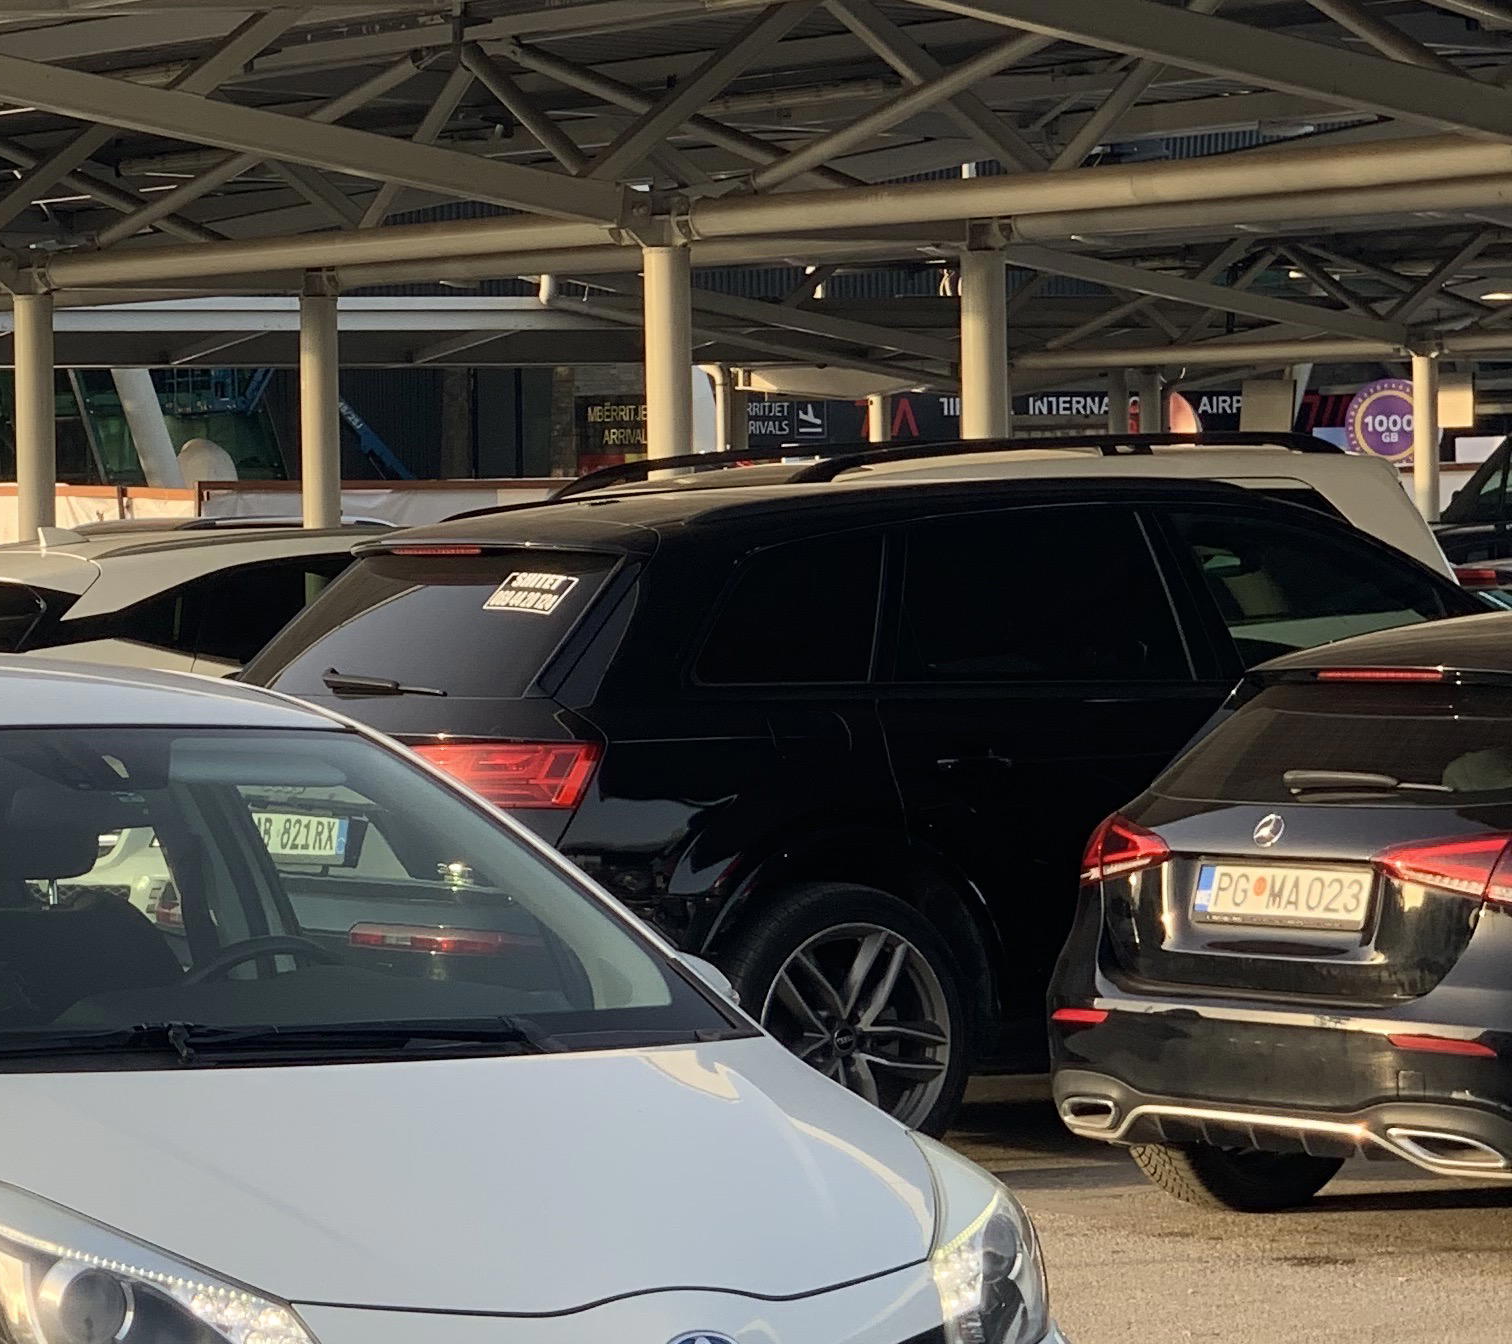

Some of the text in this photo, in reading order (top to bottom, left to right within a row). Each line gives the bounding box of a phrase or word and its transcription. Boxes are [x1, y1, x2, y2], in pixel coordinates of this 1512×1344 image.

[1364, 414, 1414, 432] 1000
[1381, 432, 1399, 443] GB
[511, 572, 567, 590] SHITET
[280, 818, 311, 850] 821
[313, 820, 336, 850] RX
[1213, 872, 1250, 907] PG
